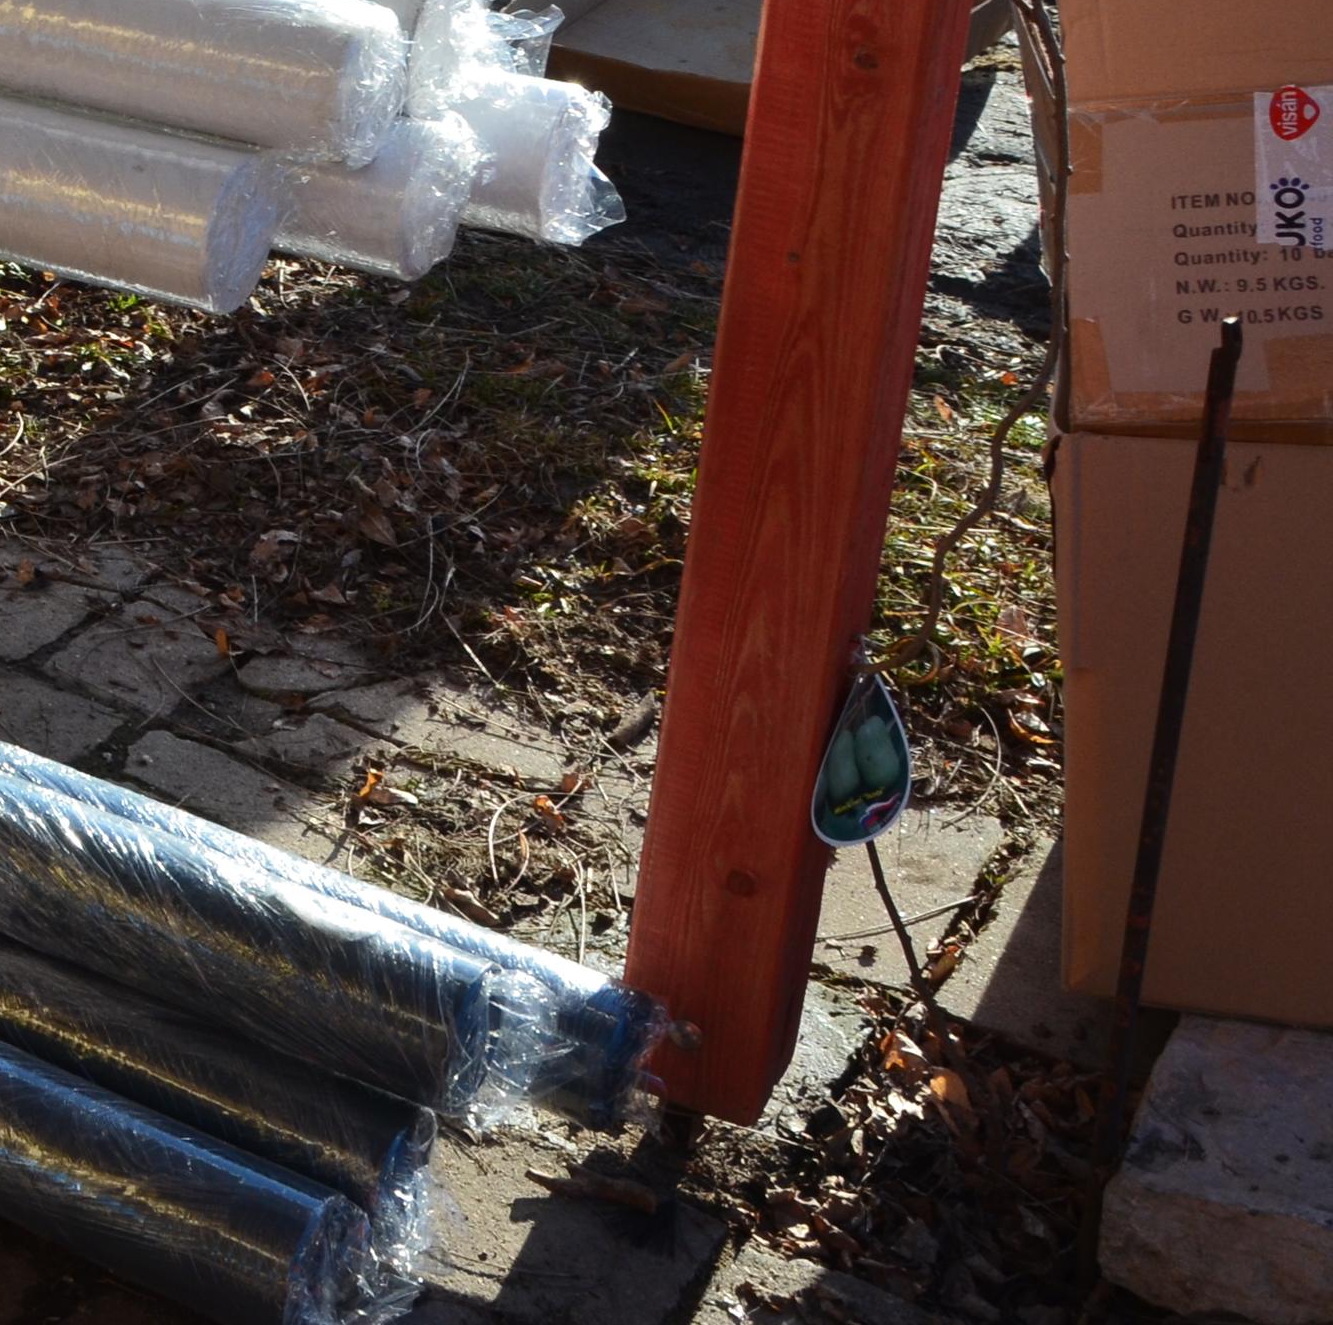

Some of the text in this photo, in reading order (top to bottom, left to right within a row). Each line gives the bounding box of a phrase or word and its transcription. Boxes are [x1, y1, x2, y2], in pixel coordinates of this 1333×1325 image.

[1171, 193, 1220, 210] ITEM
[1173, 221, 1256, 238] Quantity
[1174, 249, 1268, 267] Quantity:
[1279, 248, 1302, 262] 10
[1237, 276, 1267, 292] 9.5
[1273, 276, 1326, 291] KGS.
[1278, 305, 1324, 321] KGS
